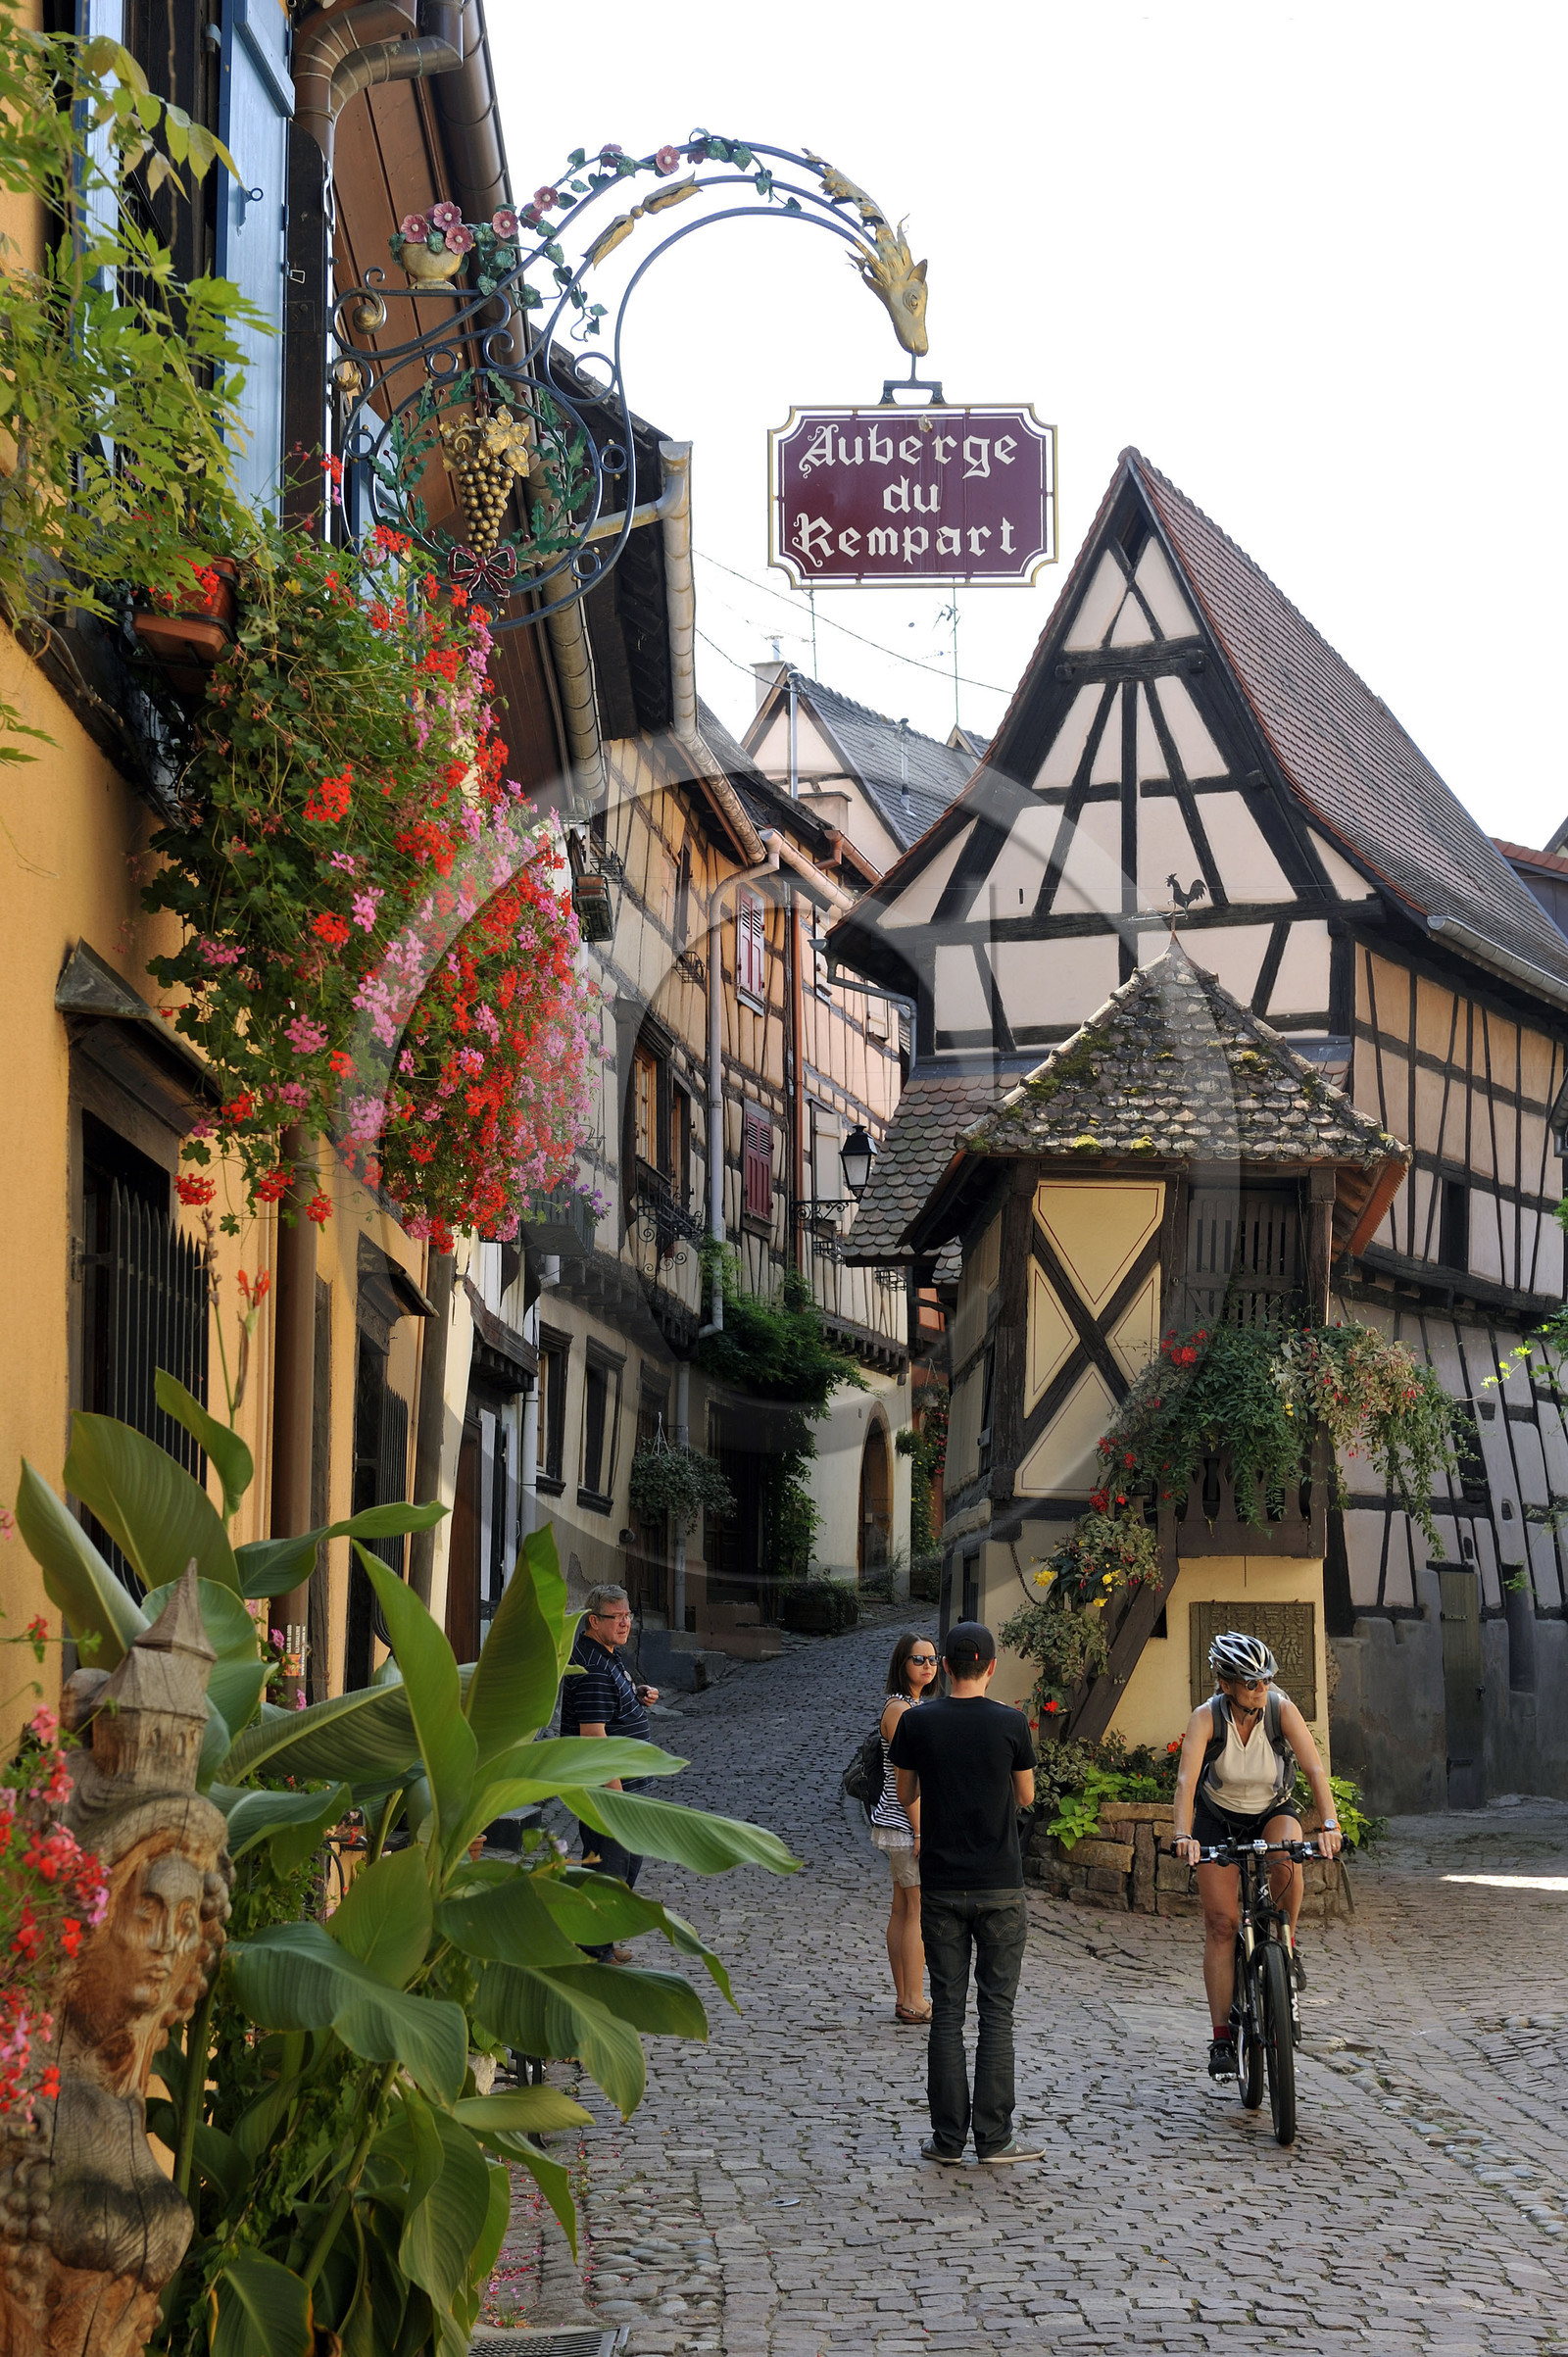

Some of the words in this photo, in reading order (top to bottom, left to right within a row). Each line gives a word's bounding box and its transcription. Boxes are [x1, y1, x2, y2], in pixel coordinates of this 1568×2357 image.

[799, 423, 1018, 479] Auberge
[883, 475, 941, 514] du
[791, 513, 1016, 568] Rempart
